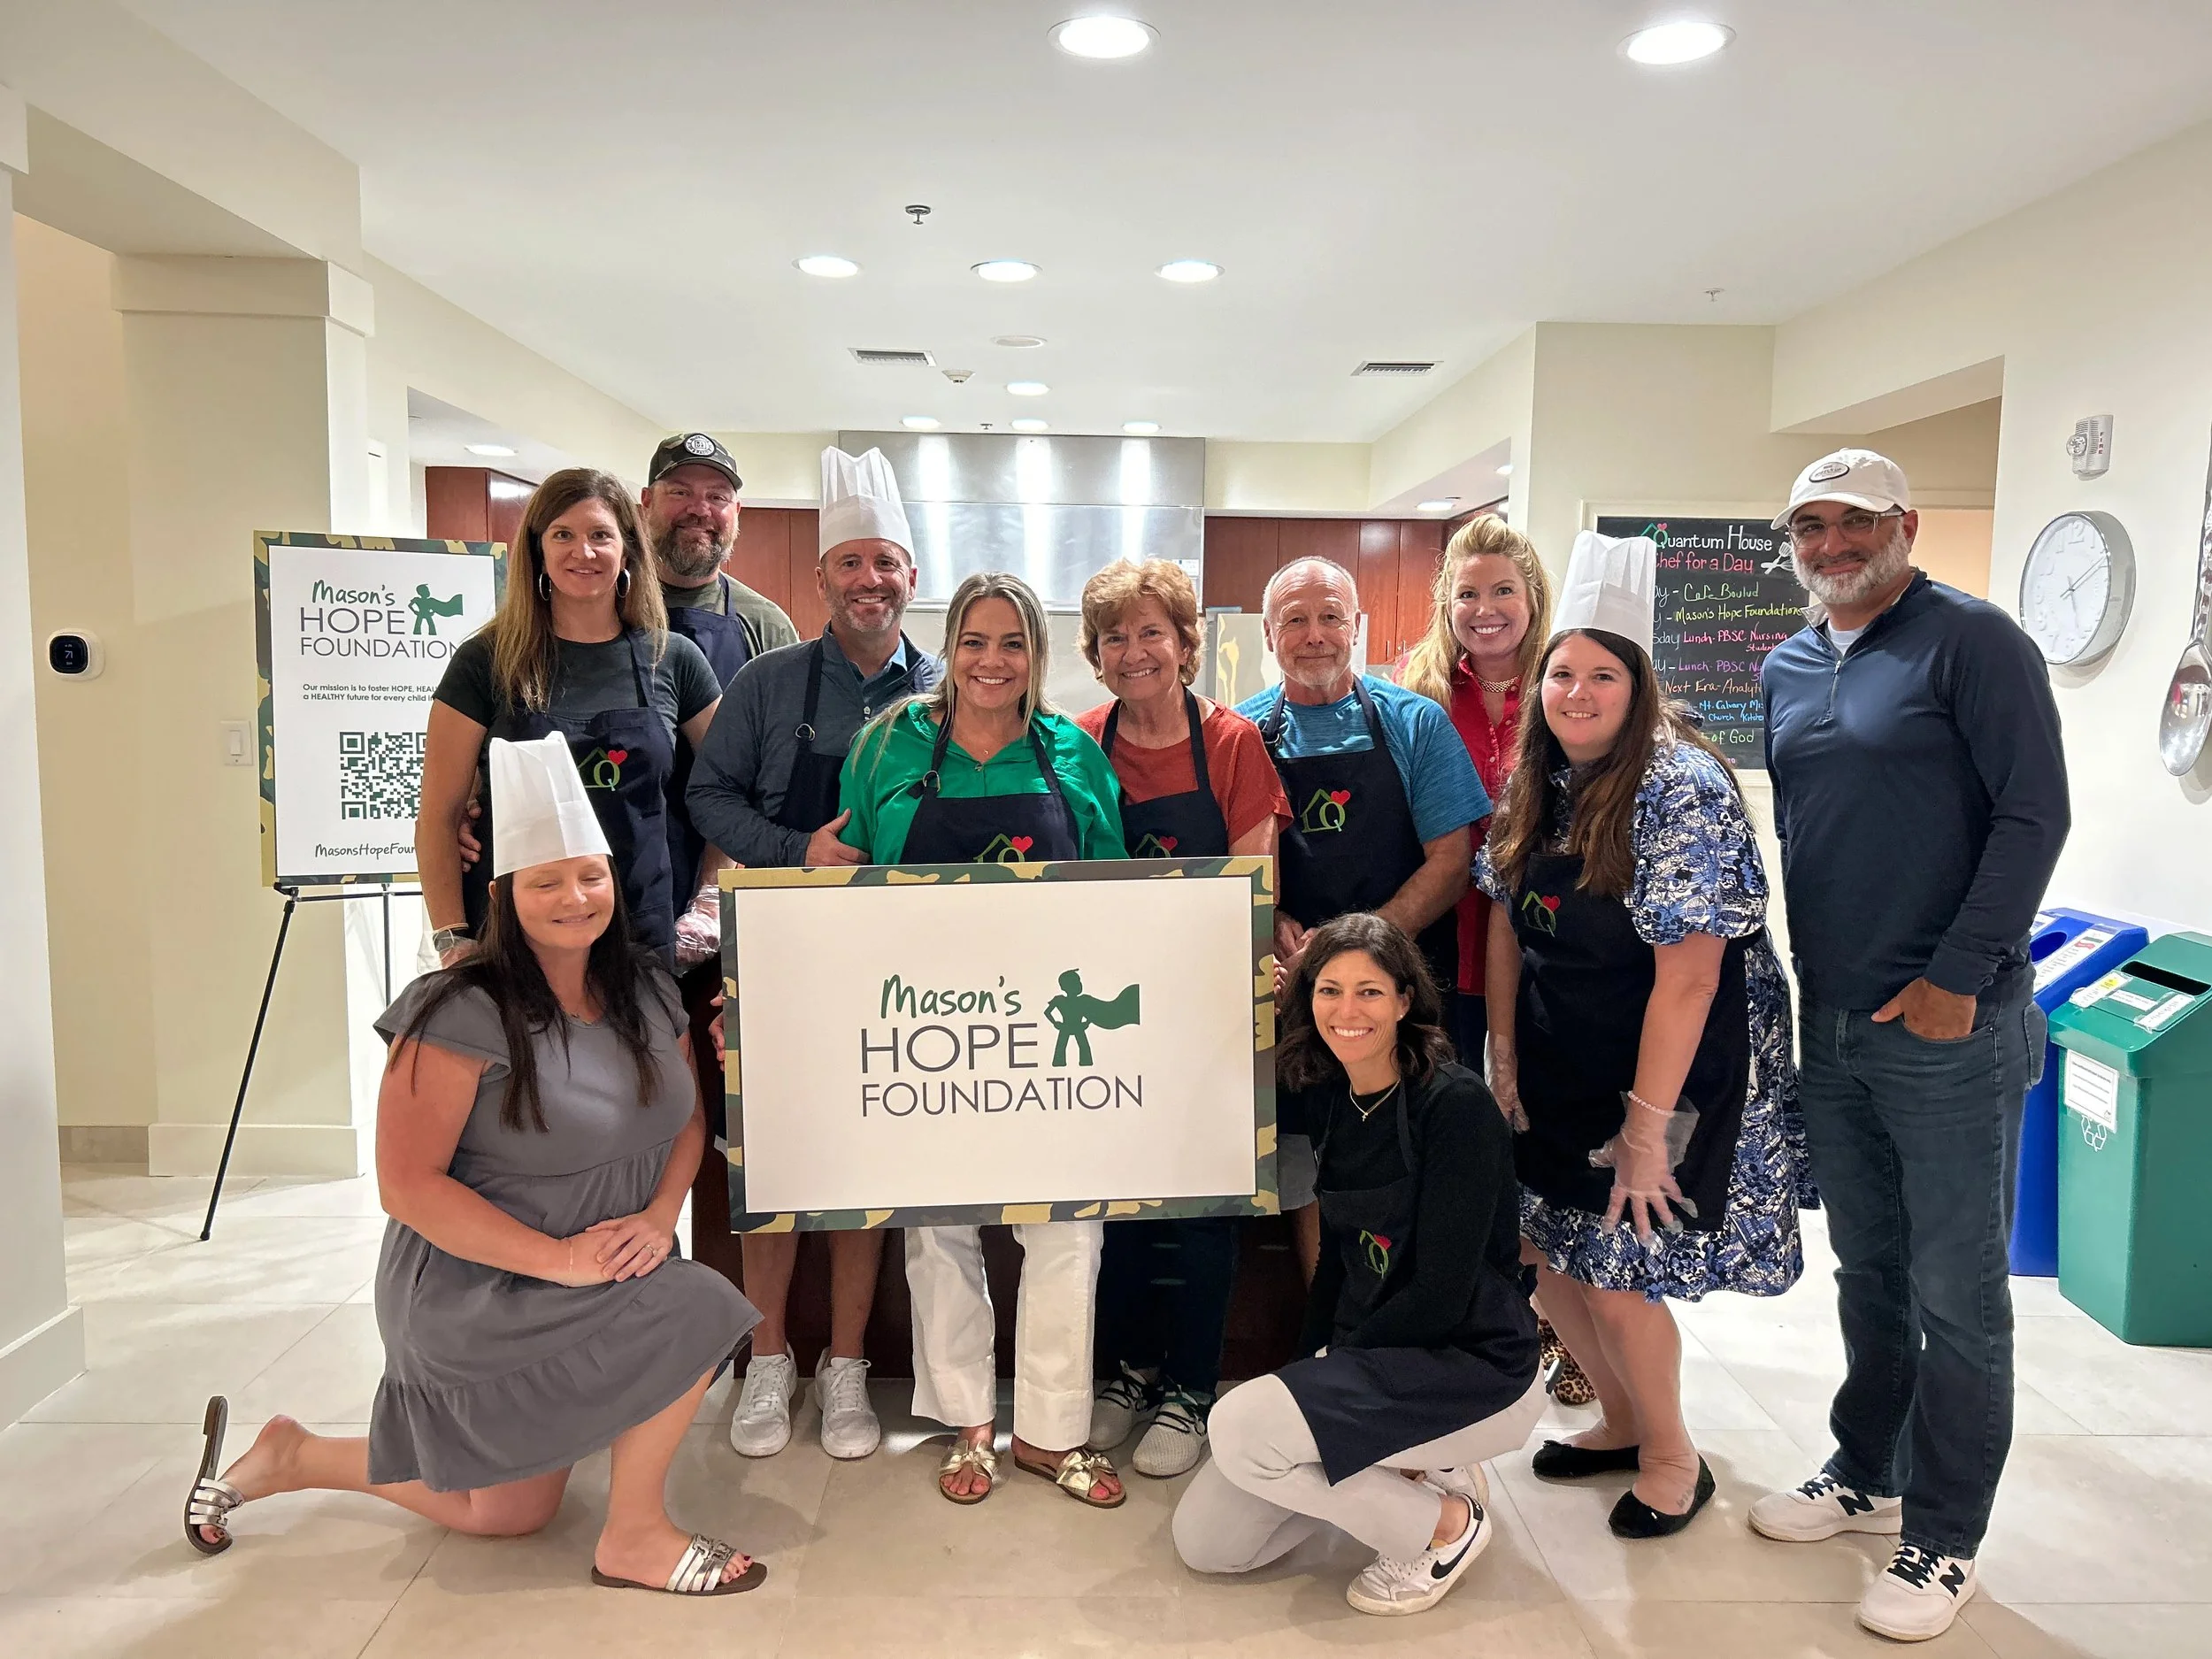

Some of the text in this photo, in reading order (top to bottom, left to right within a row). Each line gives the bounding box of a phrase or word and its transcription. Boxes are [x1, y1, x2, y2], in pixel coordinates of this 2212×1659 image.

[1655, 525, 1772, 551] Quantum House
[1686, 551, 1707, 569] for
[1709, 558, 1719, 569] a
[1723, 552, 1754, 574] Day
[312, 579, 396, 607] Mason's
[1720, 581, 1759, 600] Boulud
[300, 607, 405, 635] HOPE
[1675, 606, 1714, 625] Mason's
[1718, 602, 1743, 622] Hope
[1717, 630, 1747, 642] PBSC
[64, 650, 73, 659] 71
[1716, 660, 1746, 672] PBSC
[1665, 676, 1691, 695] Next
[1709, 713, 1735, 722] Church
[1716, 700, 1747, 718] Calvary
[1729, 729, 1754, 744] God
[881, 974, 1022, 1018] Mason's
[861, 1022, 1038, 1073] HOPE
[862, 1075, 1142, 1117] FOUNDATION
